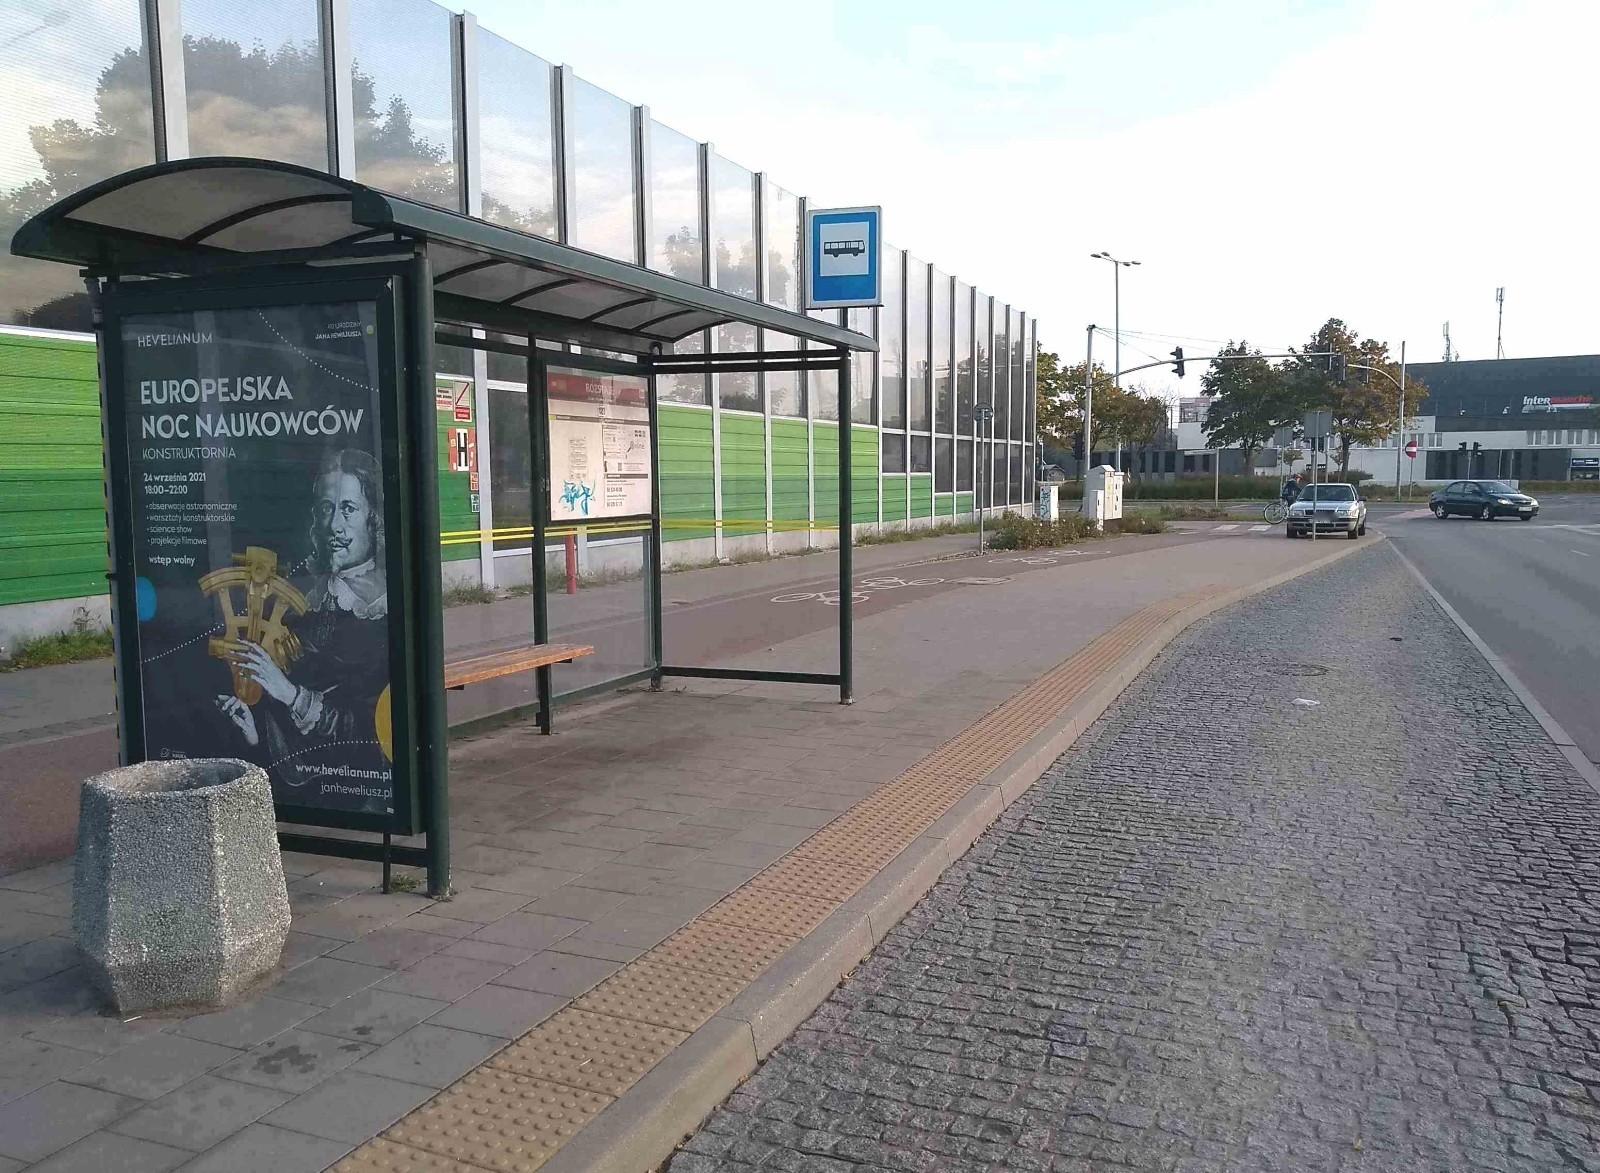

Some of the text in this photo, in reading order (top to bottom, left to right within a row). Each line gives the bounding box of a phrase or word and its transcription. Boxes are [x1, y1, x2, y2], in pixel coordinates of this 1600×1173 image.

[137, 332, 213, 347] HEVELIANUM
[140, 376, 293, 405] EUROPEJSKA
[141, 404, 364, 440] NOC NAUKOWCÓW
[142, 447, 237, 460] KONSTRUKTORNIA
[143, 472, 207, 482] 24 września 2021
[182, 513, 235, 522] konstruktorskie
[149, 555, 195, 567] wstęp wolny
[296, 764, 392, 782] www.hevelianum.pl
[320, 782, 392, 800] janheweliusz.pl
